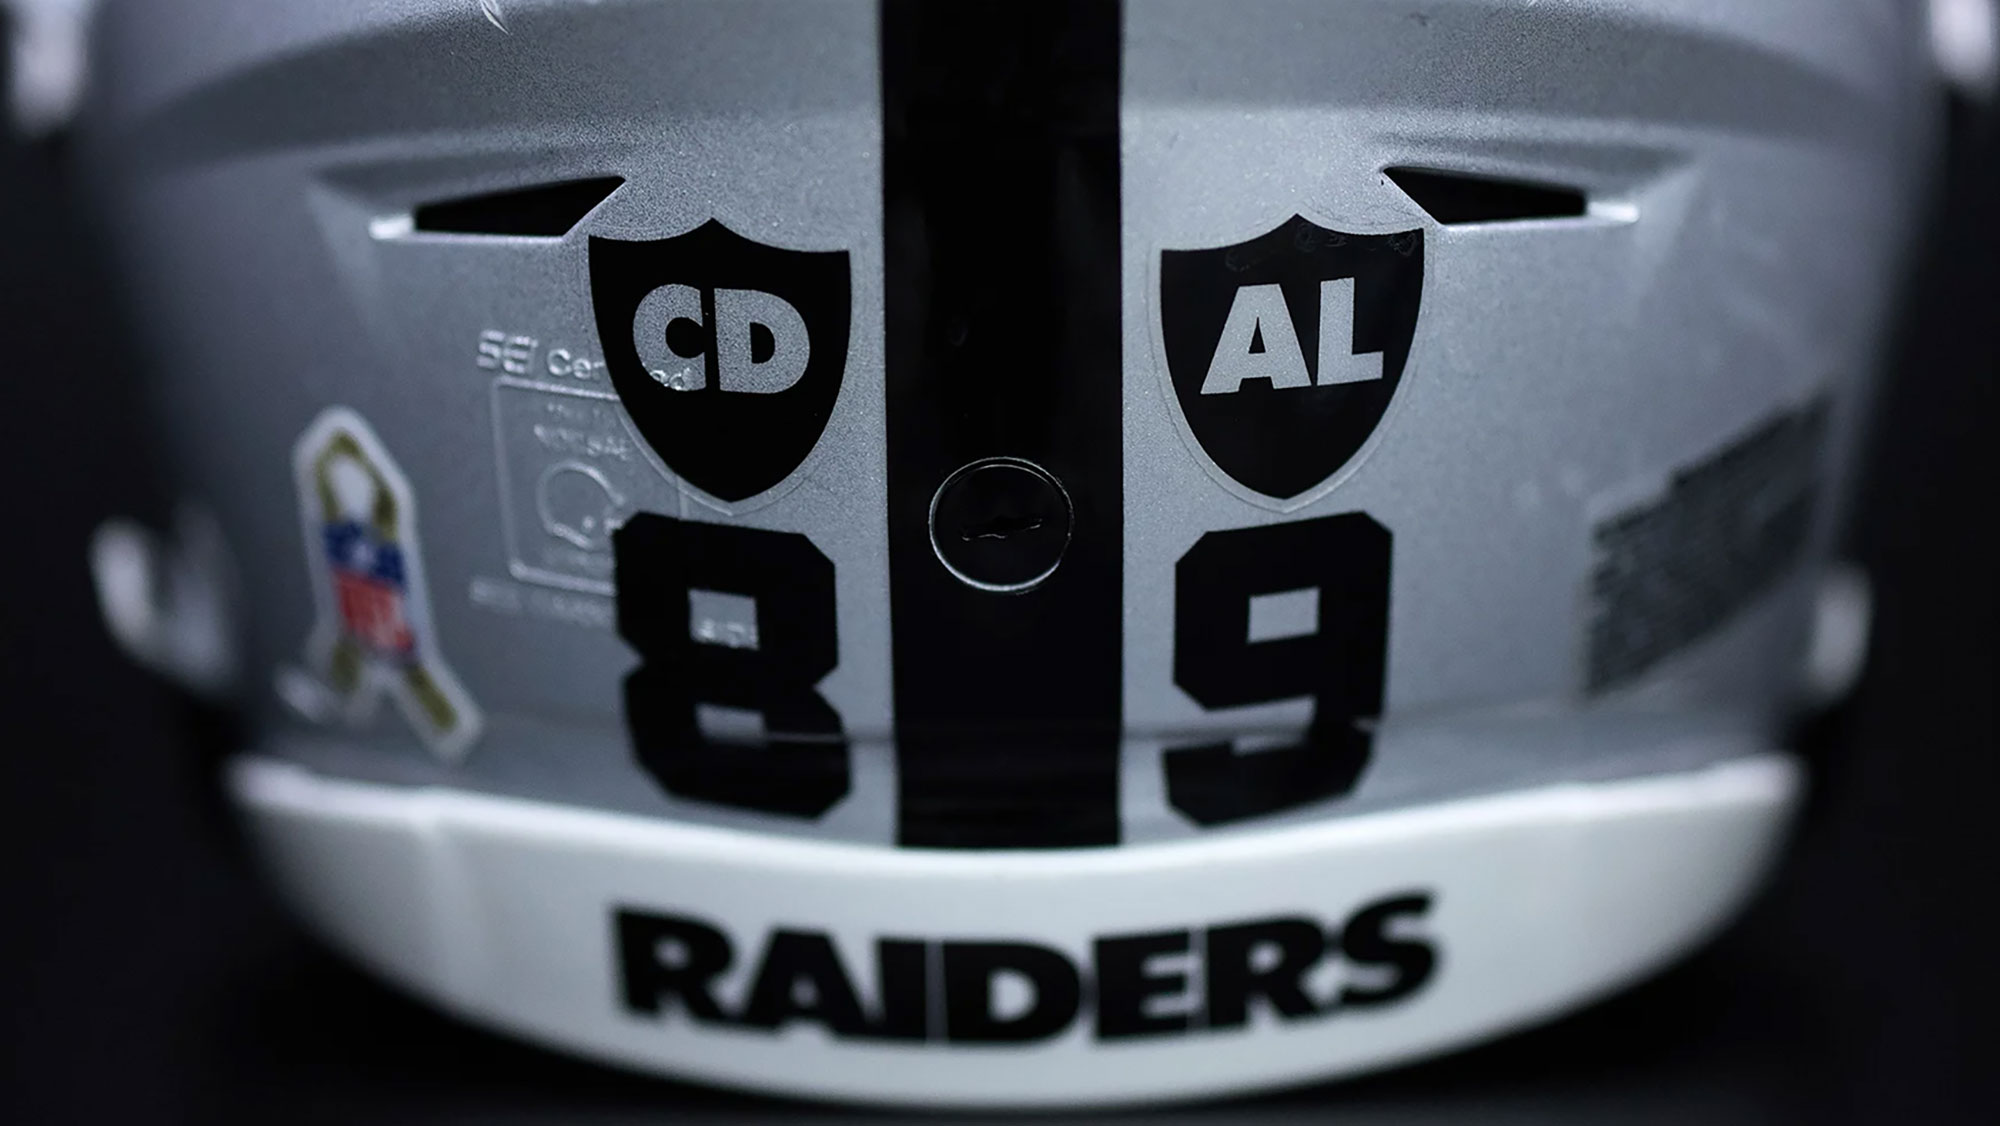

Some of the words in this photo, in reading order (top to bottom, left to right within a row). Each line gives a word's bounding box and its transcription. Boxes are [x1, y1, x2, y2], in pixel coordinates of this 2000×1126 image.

[633, 283, 811, 394] CD
[1200, 277, 1384, 395] AL
[609, 889, 1441, 1050] RAIDERS
